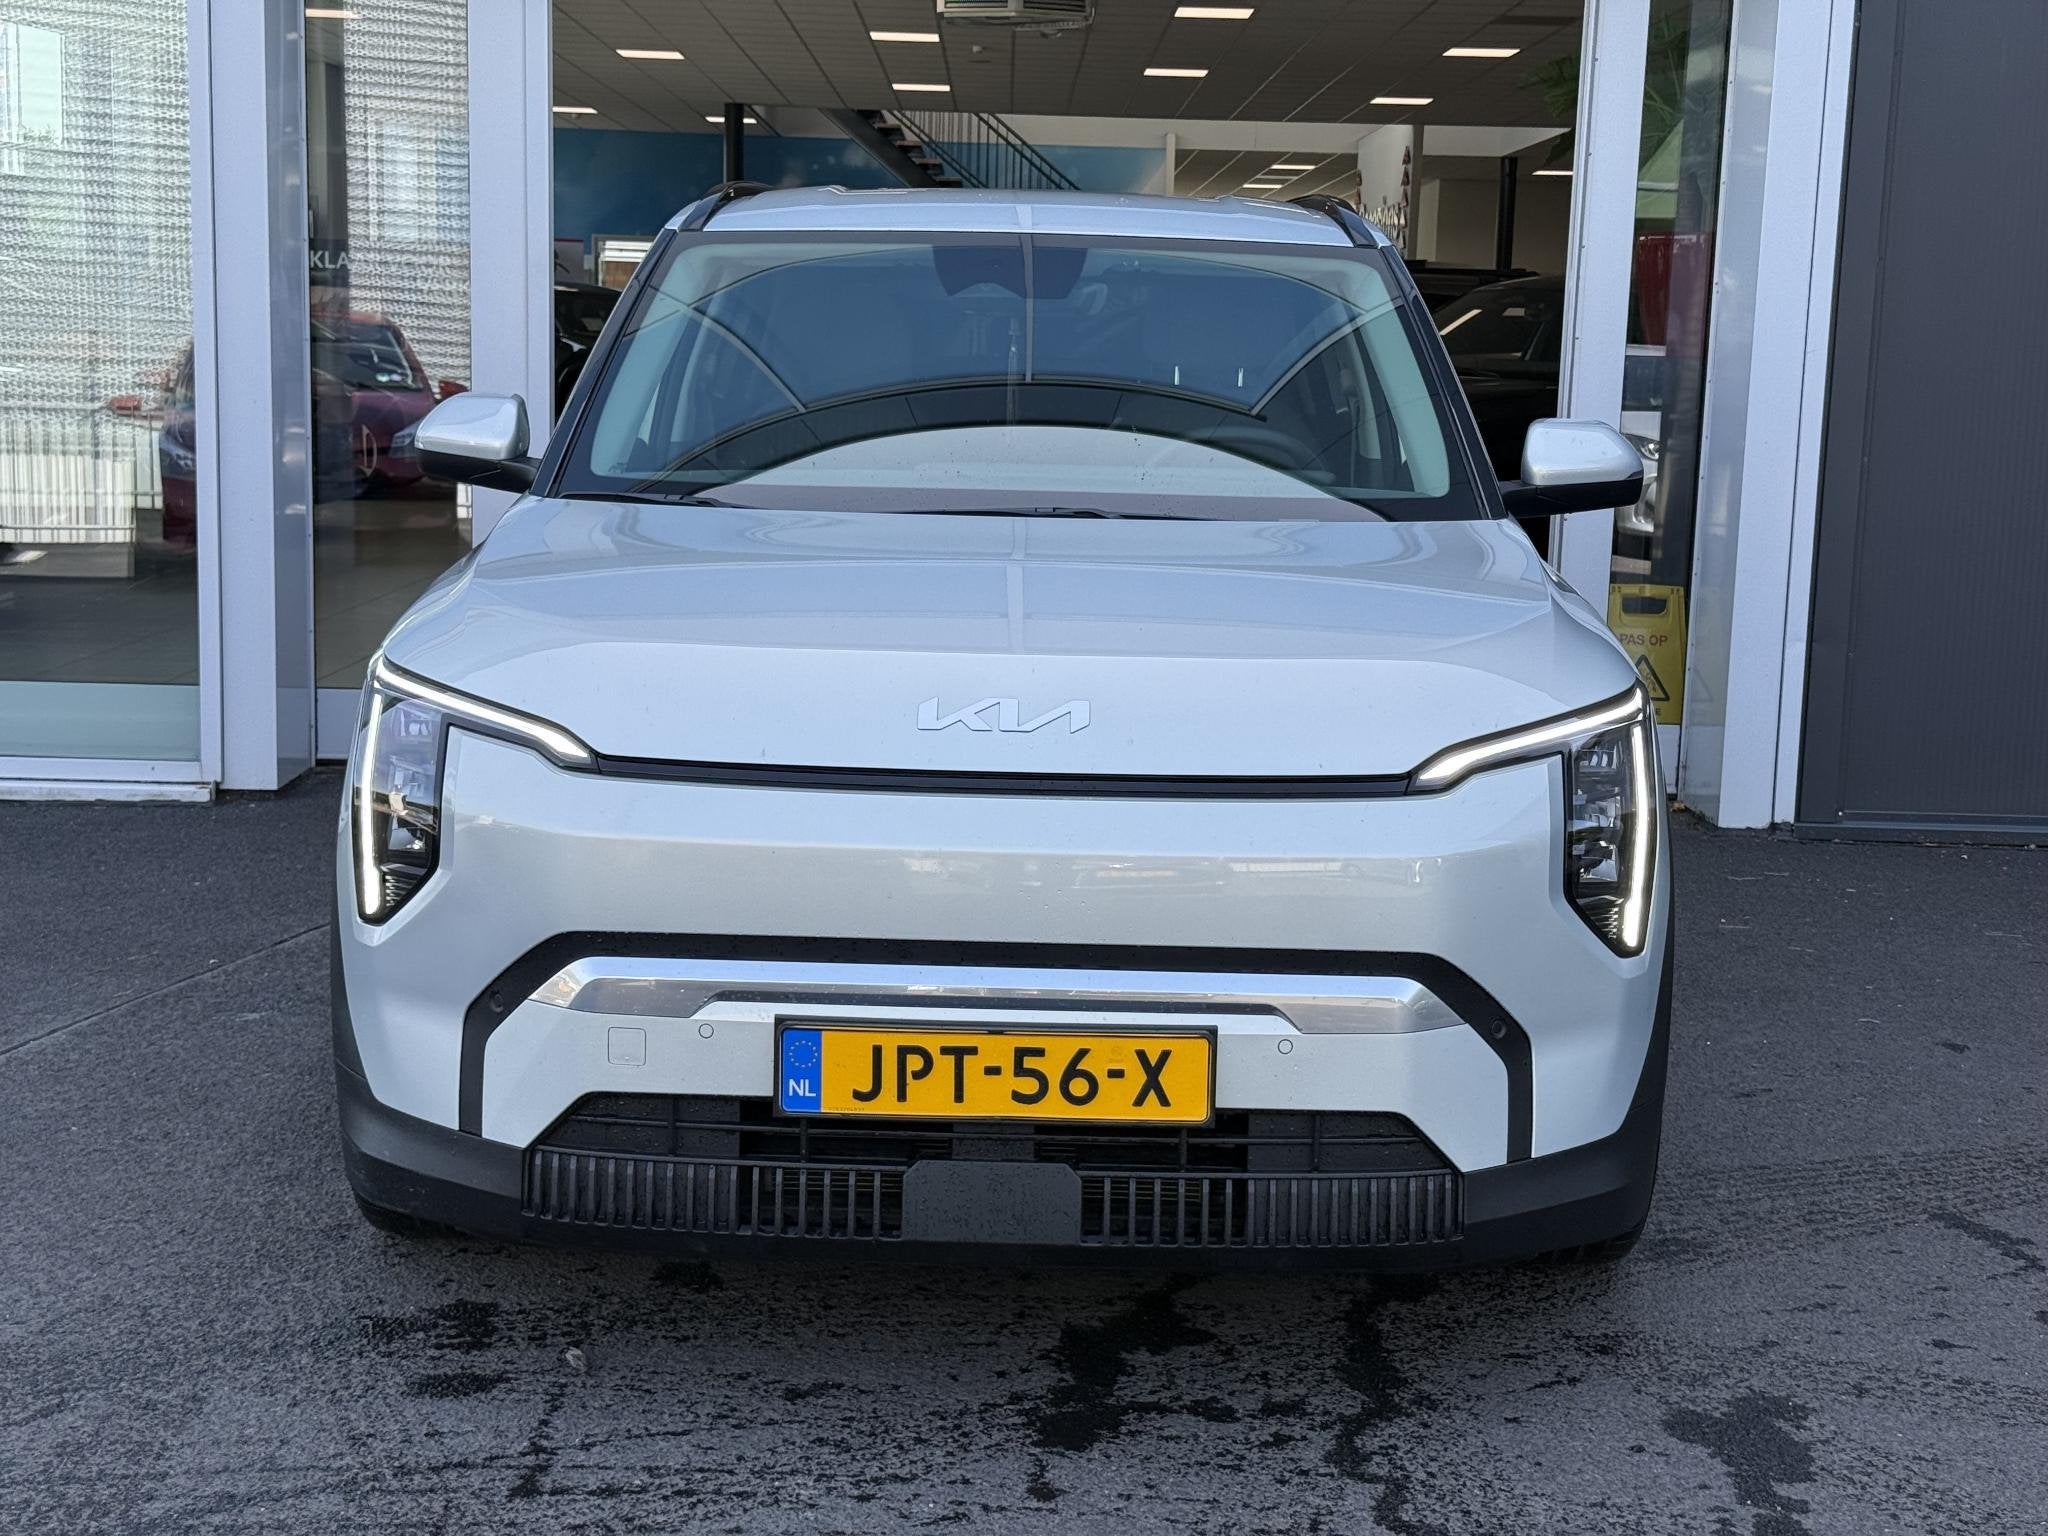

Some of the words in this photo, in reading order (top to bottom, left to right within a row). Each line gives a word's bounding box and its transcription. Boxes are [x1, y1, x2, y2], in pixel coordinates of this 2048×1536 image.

[1619, 633, 1645, 646] PAS
[1648, 635, 1668, 646] OP
[917, 696, 1090, 734] KIA
[788, 1078, 817, 1097] NL
[852, 1044, 1173, 1107] JPT-56-X
